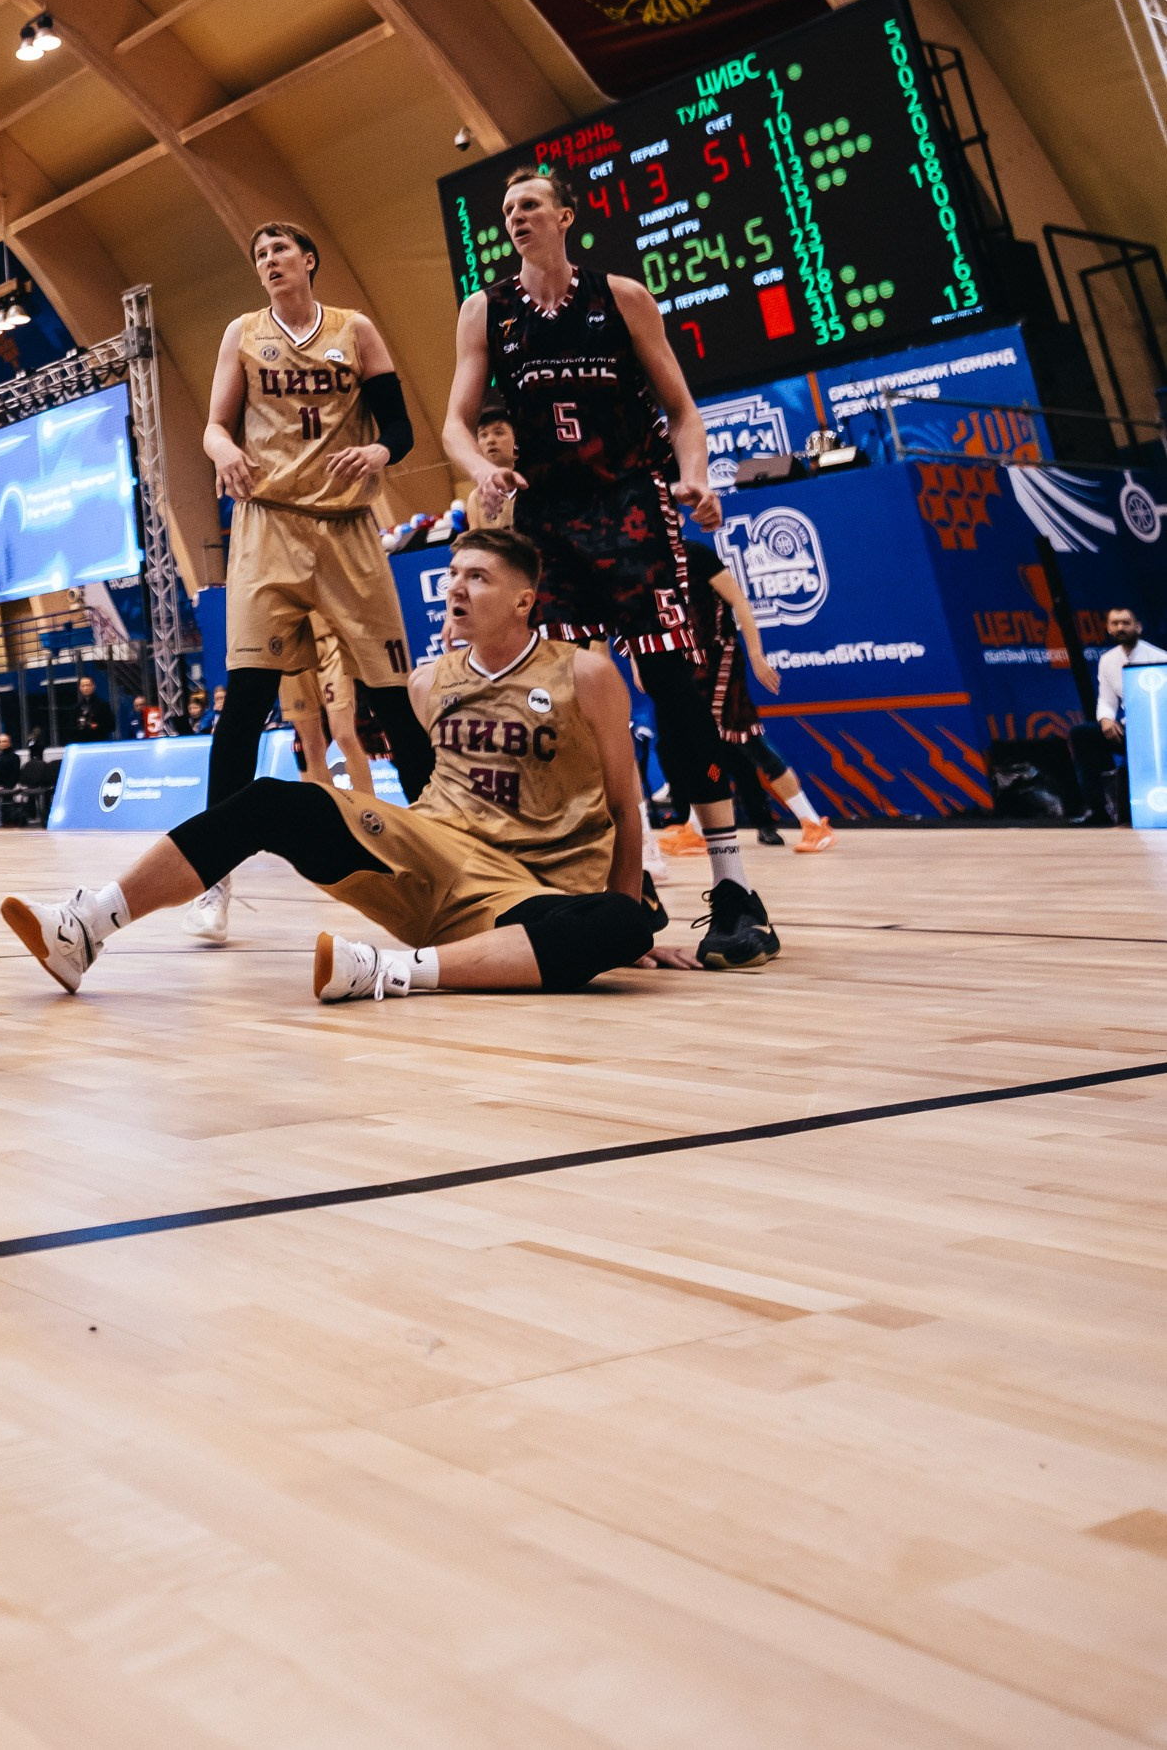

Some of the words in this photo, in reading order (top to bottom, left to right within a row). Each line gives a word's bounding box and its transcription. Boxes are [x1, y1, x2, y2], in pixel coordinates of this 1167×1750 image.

[884, 19, 901, 45] 5
[891, 43, 907, 66] 0
[695, 52, 761, 97] ЦИВС
[766, 68, 779, 90] 1
[897, 65, 914, 89] 0
[675, 96, 719, 126] ТУЛА
[770, 88, 784, 114] 7
[903, 88, 922, 113] 2
[764, 111, 791, 140] 10
[912, 111, 928, 135] 0
[703, 132, 751, 183] 51
[769, 133, 795, 162] 11
[918, 134, 936, 159] 6
[646, 162, 669, 205] 3
[775, 155, 803, 184] 13
[908, 157, 943, 189] 18
[588, 179, 630, 218] 41
[780, 176, 809, 206] 15
[932, 182, 949, 207] 0
[456, 196, 467, 216] 2
[786, 199, 813, 228] 17
[939, 206, 957, 231] 0
[459, 216, 470, 235] 3
[790, 222, 821, 253] 23
[463, 232, 474, 253] 5
[946, 230, 961, 256] 1
[465, 252, 477, 272] 9
[796, 244, 825, 277] 27
[953, 254, 971, 281] 6
[802, 267, 833, 299] 28
[943, 280, 978, 310] 13
[807, 292, 837, 322] 31
[813, 314, 845, 345] 35
[259, 367, 352, 398] ЦИВС
[298, 407, 322, 440] 11
[553, 402, 582, 442] 5
[654, 588, 687, 629] 5
[384, 639, 407, 673] 11
[438, 718, 558, 763] ЦИВС
